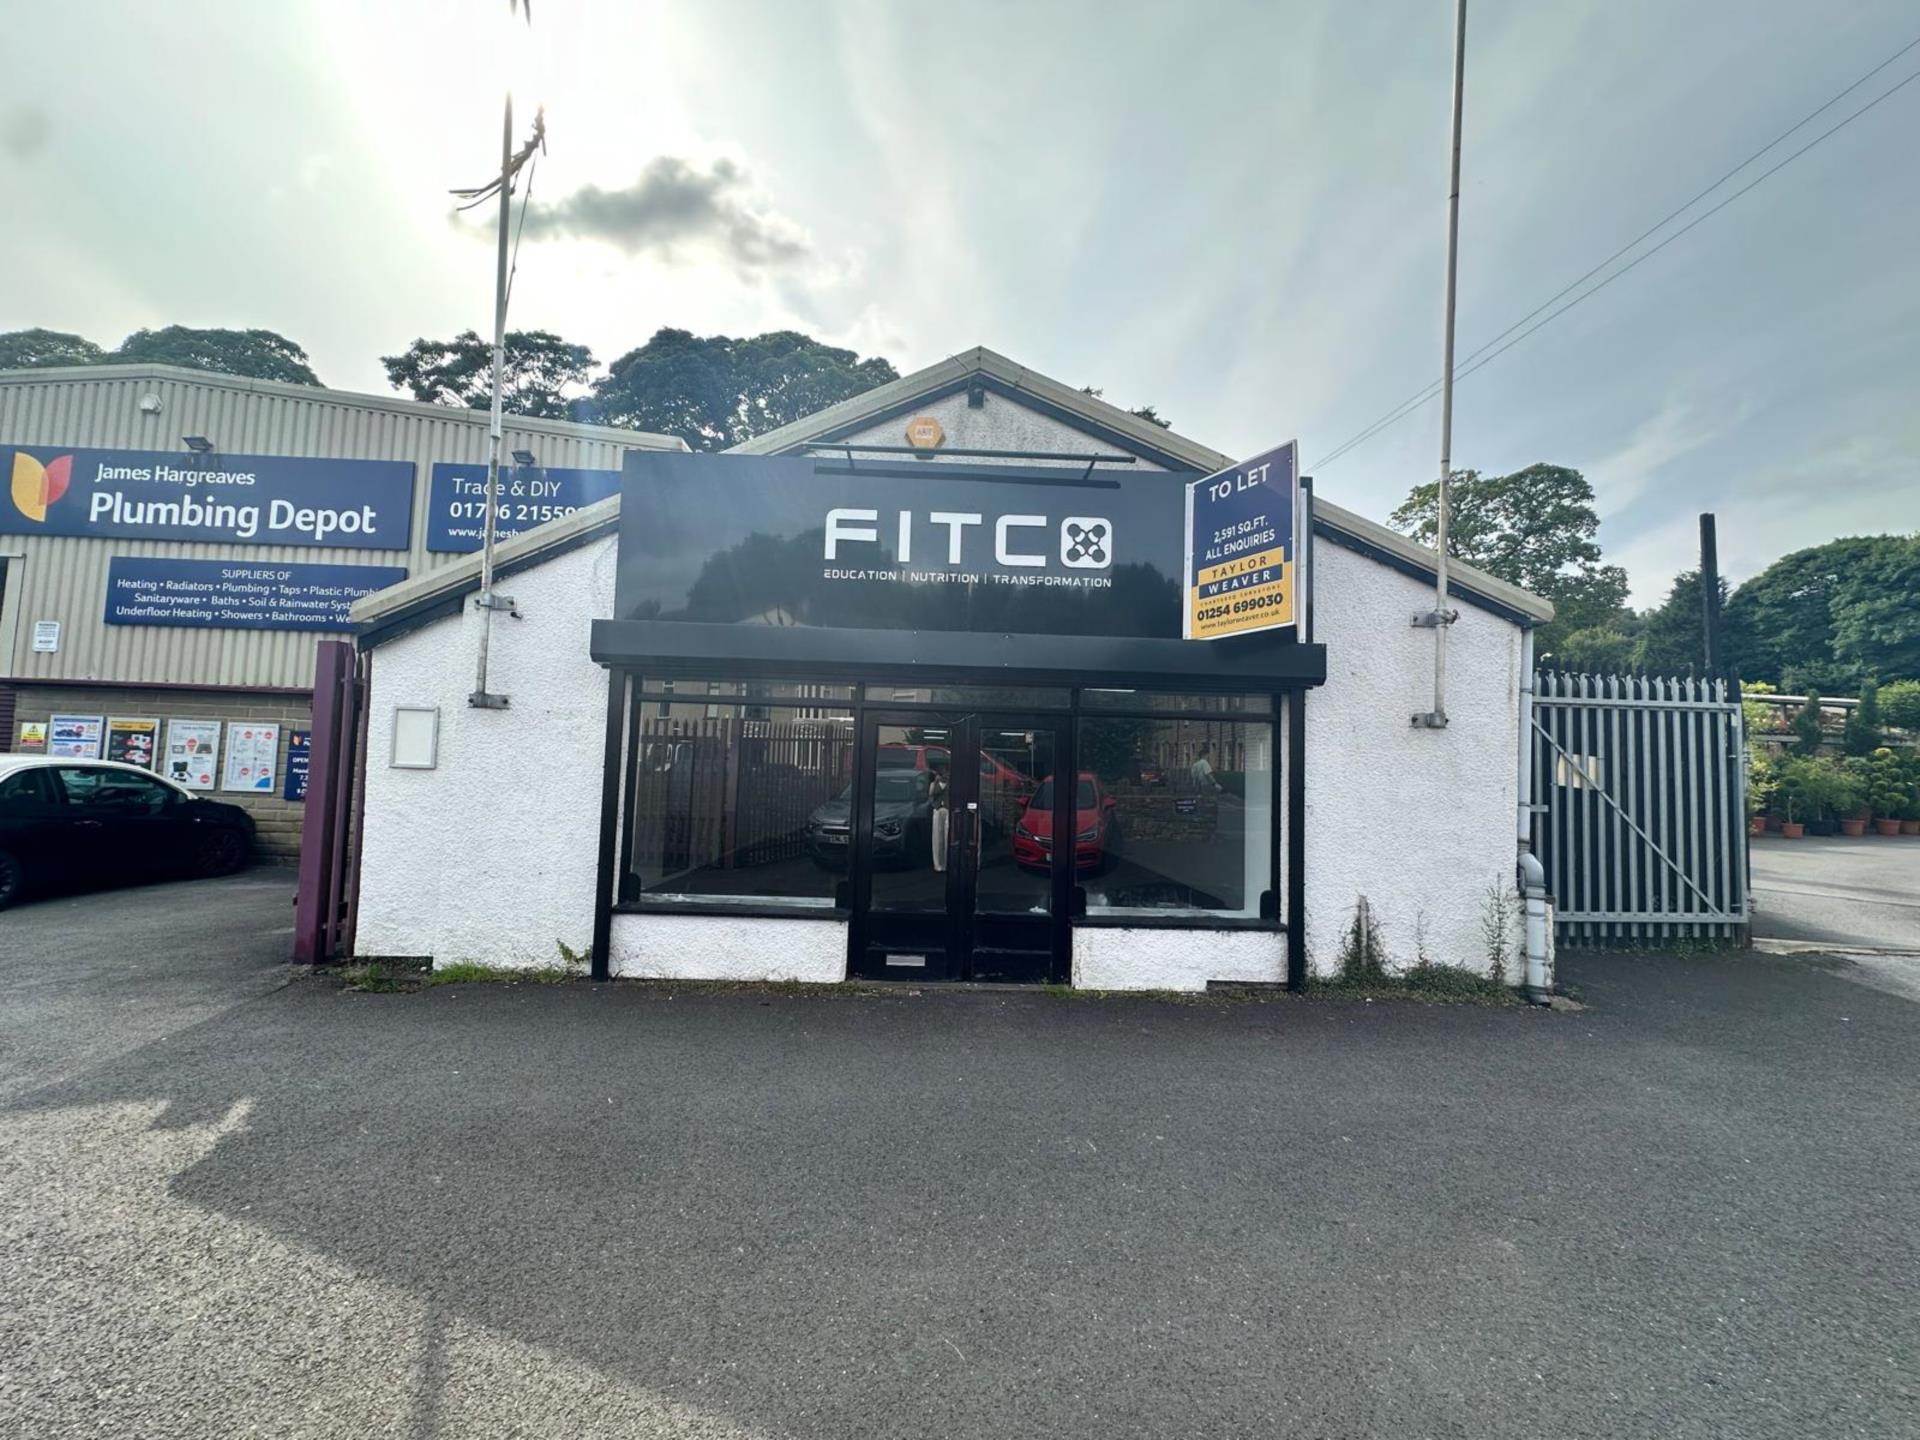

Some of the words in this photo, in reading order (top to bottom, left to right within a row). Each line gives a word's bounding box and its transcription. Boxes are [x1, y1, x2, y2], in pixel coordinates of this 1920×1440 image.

[94, 463, 151, 482] James
[154, 465, 256, 487] Hargreaves
[1208, 480, 1231, 502] TO
[1237, 463, 1271, 492] LET
[510, 480, 525, 497] &
[530, 480, 562, 497] DIY
[89, 491, 259, 537] Plumbing
[268, 500, 377, 541] Depot
[450, 502, 511, 519] 0176
[516, 504, 585, 521] 2155
[1213, 526, 1236, 544] 2,591
[1237, 515, 1268, 534] SQ.FT.
[1205, 547, 1222, 560] ALL
[1224, 529, 1275, 555] ENQUIRIES
[221, 569, 275, 580] SUPPLIERS
[277, 571, 292, 581] OF
[824, 569, 897, 581] EDUCATION
[910, 572, 979, 583] NUTRITION
[993, 574, 1112, 587] TRANSFORMATION
[1212, 556, 1267, 578] TAYLOR
[117, 579, 157, 592] Heating
[166, 580, 214, 591] Radiators
[222, 582, 270, 595] Plumbing
[279, 584, 301, 597] Taps
[309, 585, 342, 597] Plastic
[344, 587, 379, 598] Plumb
[1208, 570, 1271, 594] WEAVER
[134, 593, 200, 606] Sanitaryware
[211, 595, 240, 606] Baths
[248, 597, 267, 607] Soil
[268, 598, 278, 607] &
[279, 598, 328, 609] Rainwater
[330, 600, 352, 612] Syst
[1197, 604, 1231, 621] 01254
[1233, 592, 1284, 613] 699030
[116, 606, 170, 617] Underfloor
[172, 608, 212, 621] Heating
[221, 609, 263, 620] Showers
[271, 612, 327, 623] Bathrooms
